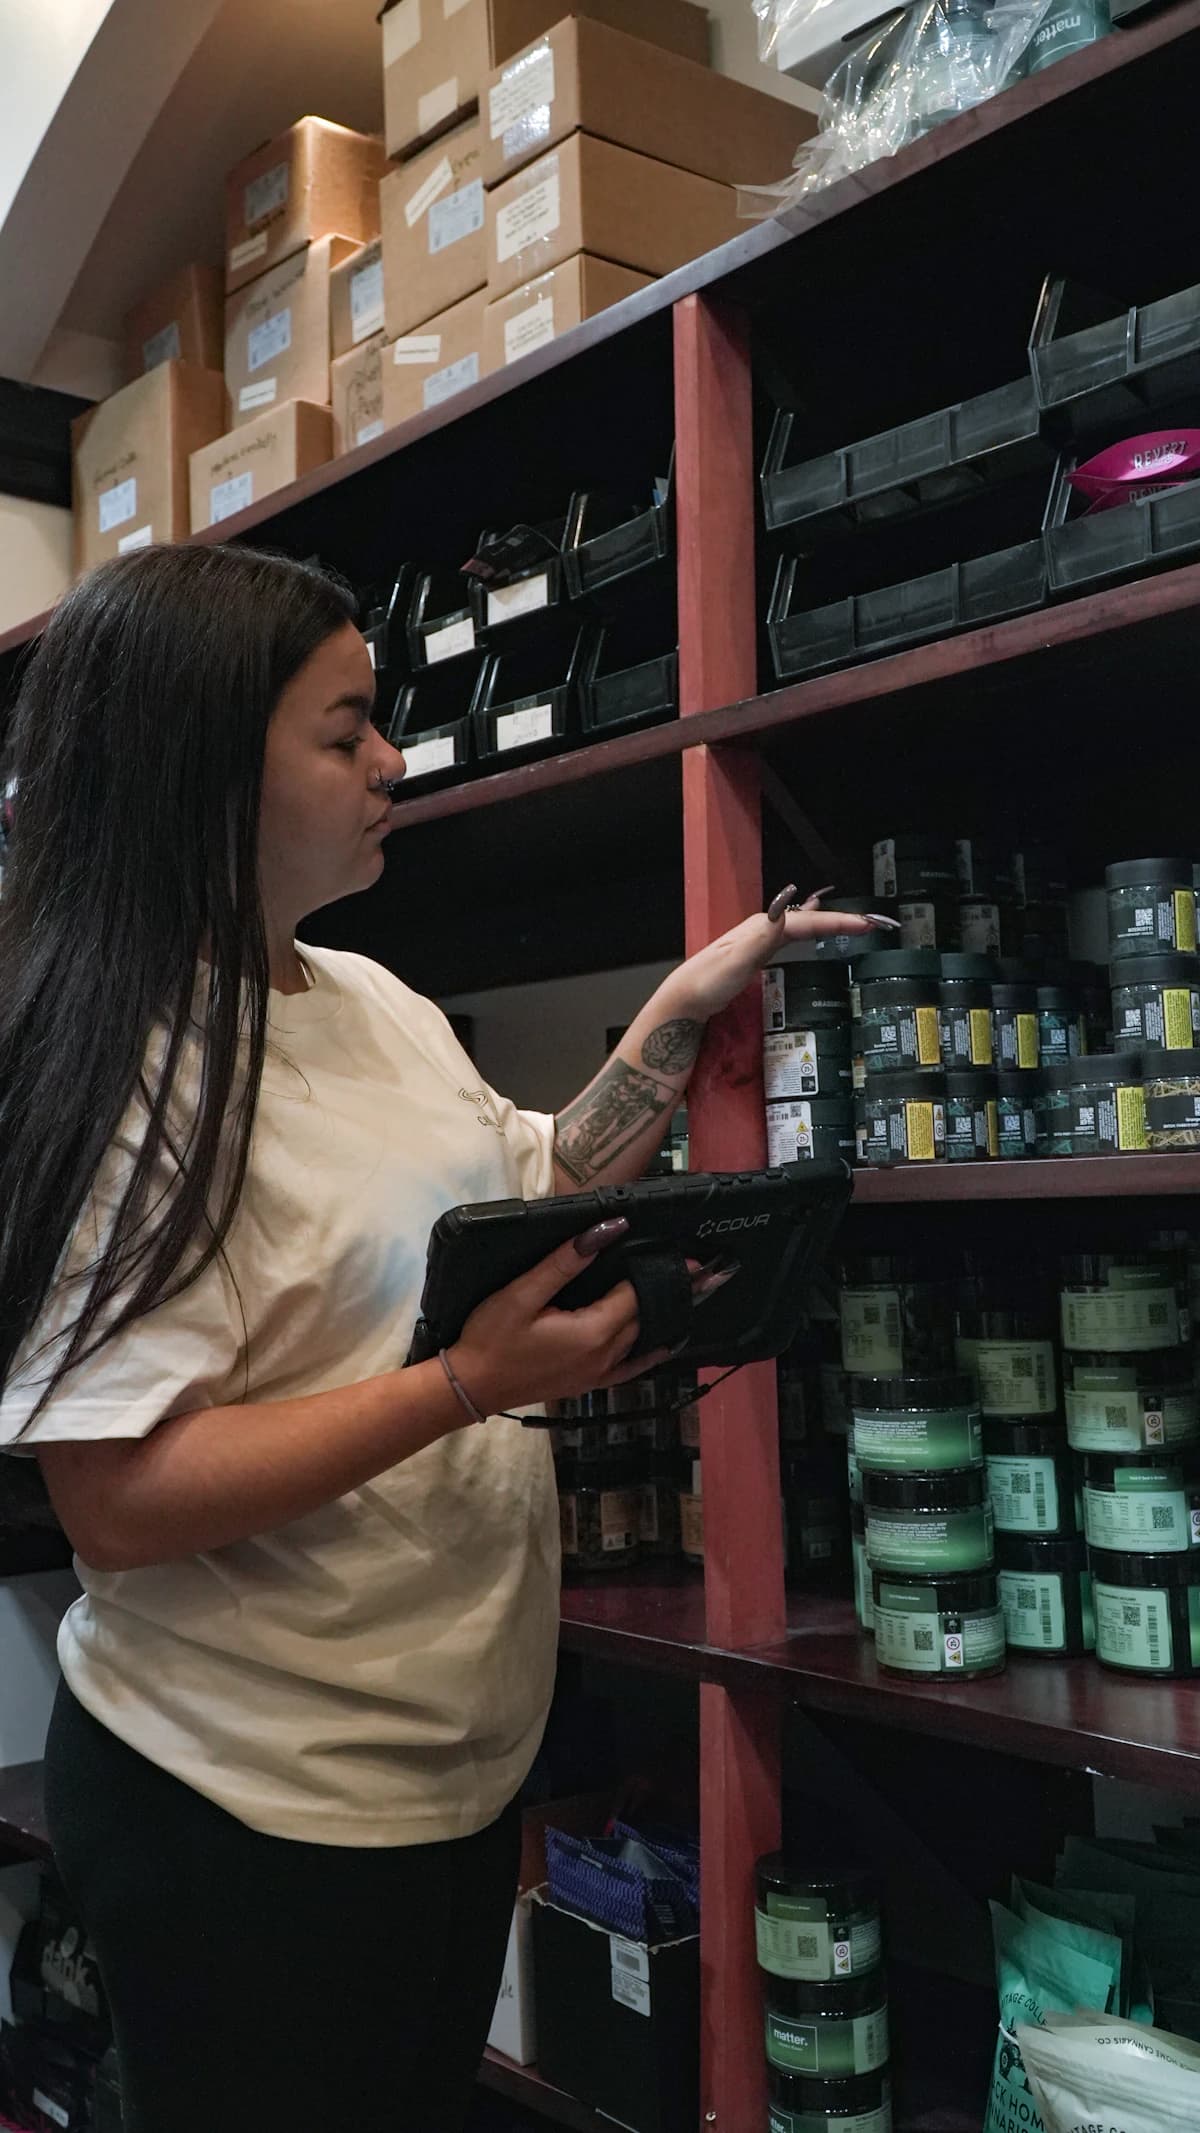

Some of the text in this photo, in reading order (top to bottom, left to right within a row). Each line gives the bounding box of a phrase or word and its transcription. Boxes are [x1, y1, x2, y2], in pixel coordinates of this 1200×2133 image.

[1134, 441, 1187, 471] REVERT
[774, 2028, 808, 2046] matter.
[1113, 2037, 1154, 2054] CANNABIS
[1008, 2094, 1045, 2132] HOM
